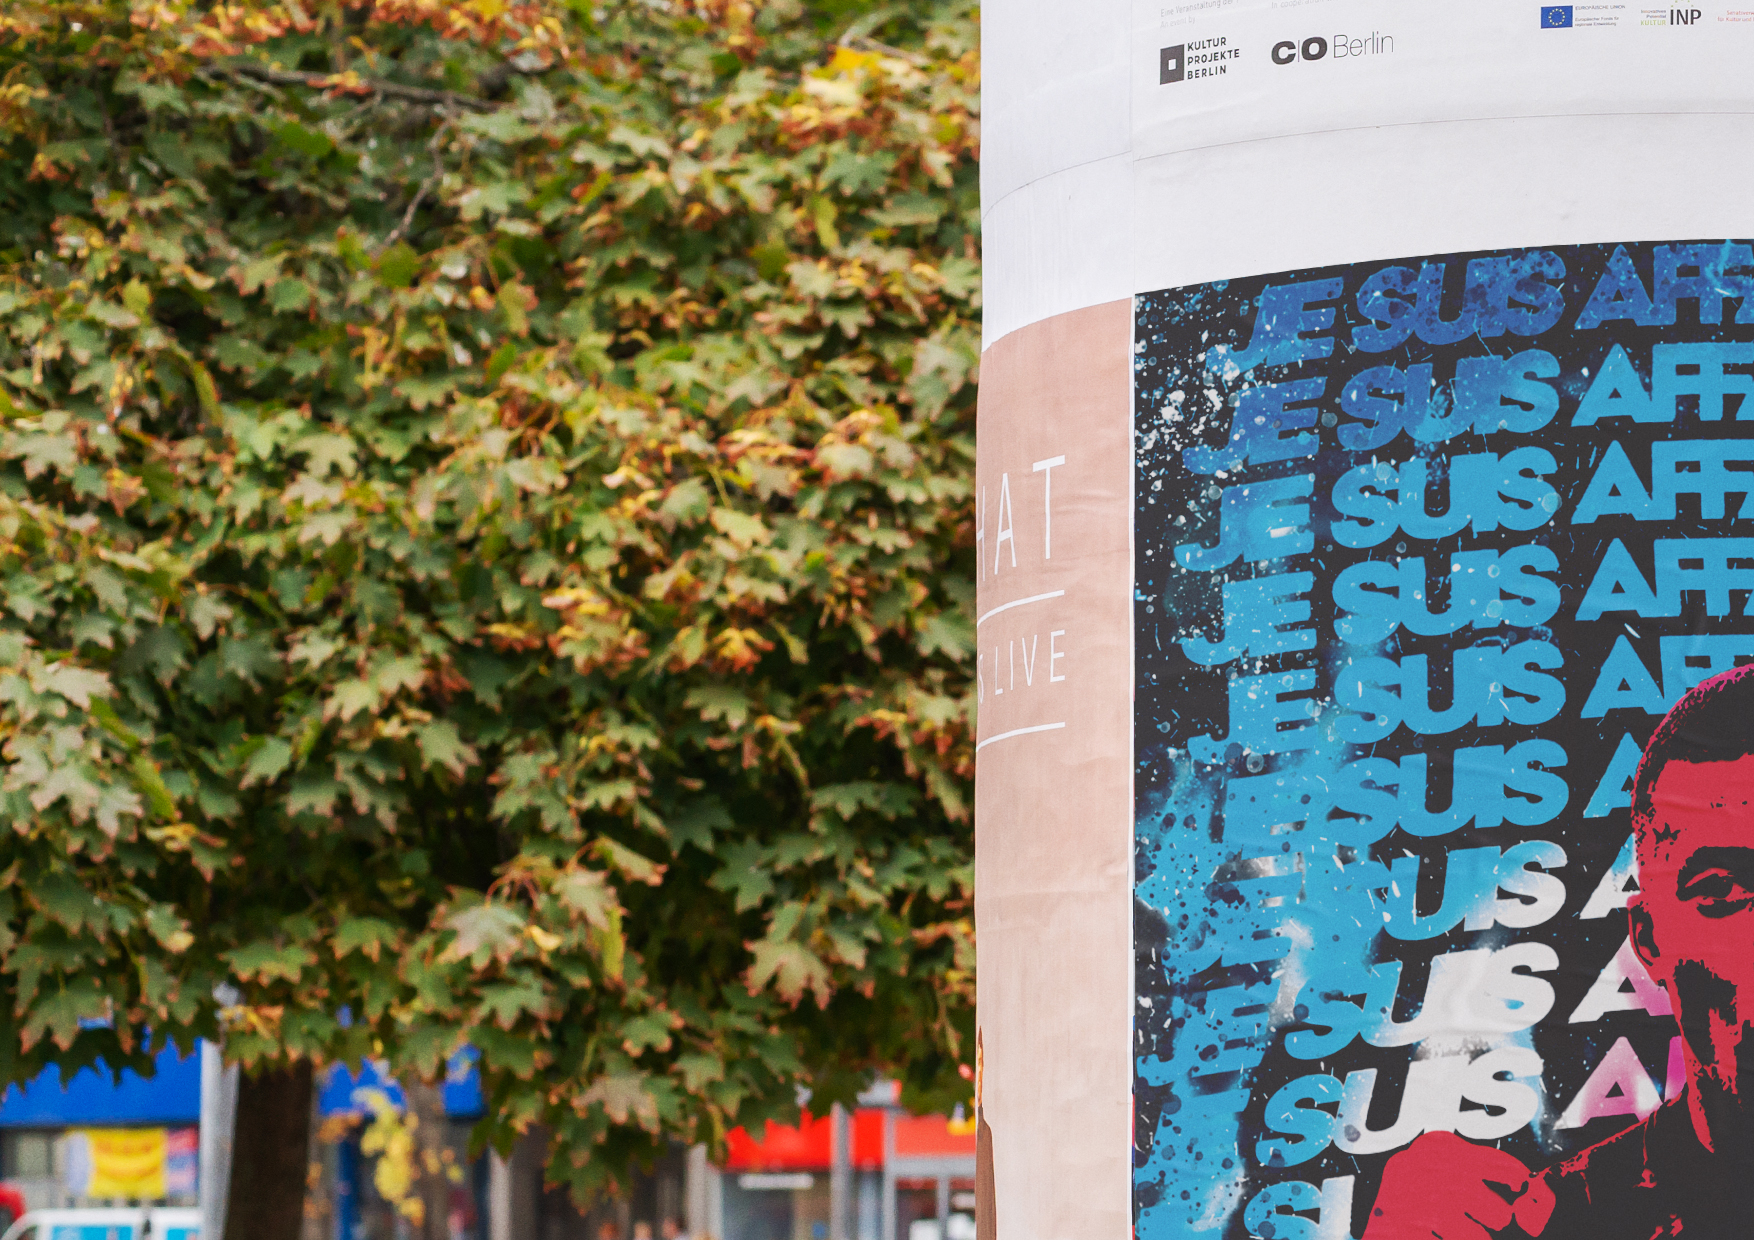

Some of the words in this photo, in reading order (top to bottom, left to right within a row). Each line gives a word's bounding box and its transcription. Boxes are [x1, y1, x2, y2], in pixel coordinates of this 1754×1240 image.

[1187, 37, 1227, 52] KULTUR
[1333, 31, 1395, 60] Berlin
[1669, 8, 1702, 26] INP
[1187, 48, 1240, 66] PROJEKTE
[1187, 65, 1227, 80] BERLIN
[1206, 277, 1345, 376] JE
[1352, 250, 1567, 353] SUIS
[1182, 376, 1327, 475] JE
[1337, 348, 1561, 451] SUIS
[1174, 473, 1316, 572] JE
[1331, 446, 1561, 549] SUIS
[1181, 571, 1314, 666] JE
[1332, 544, 1562, 648] SUIS
[1334, 640, 1567, 744] SUIS
